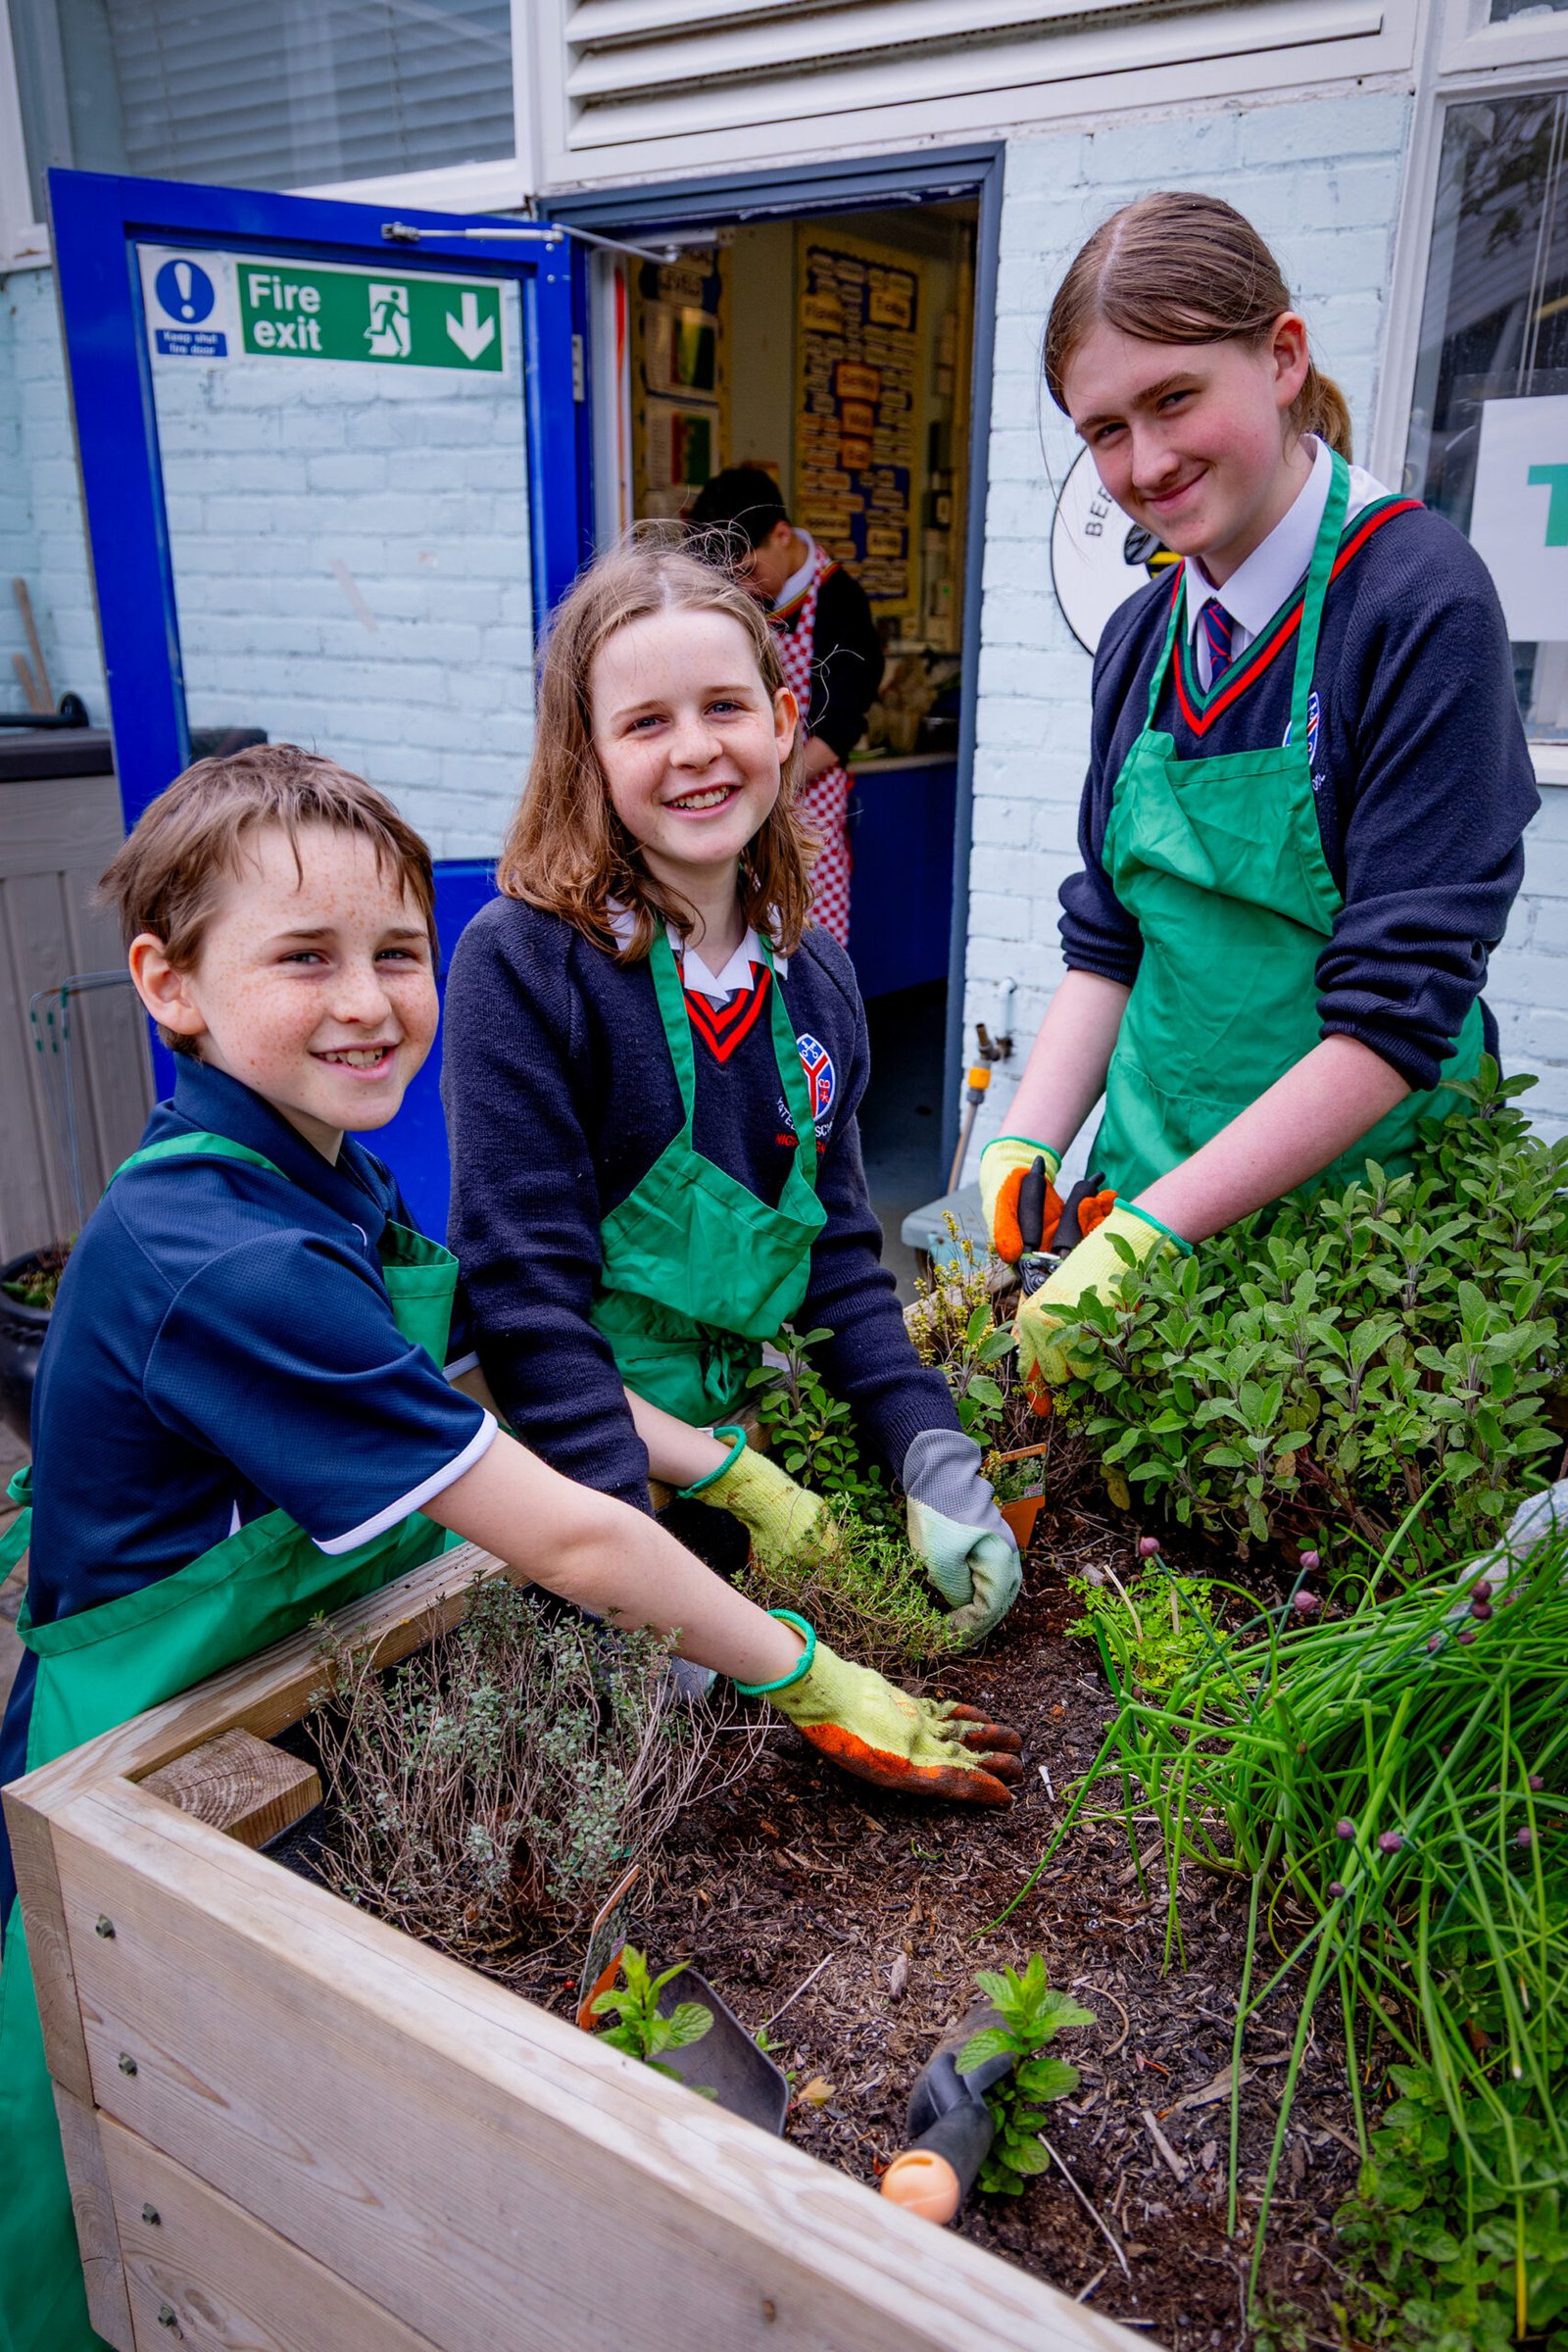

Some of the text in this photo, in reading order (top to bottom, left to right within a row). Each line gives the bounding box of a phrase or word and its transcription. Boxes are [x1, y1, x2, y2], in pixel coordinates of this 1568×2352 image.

[248, 273, 321, 314] Fire
[164, 330, 219, 345] Keep shut
[253, 316, 322, 351] exit
[170, 343, 216, 356] fire door
